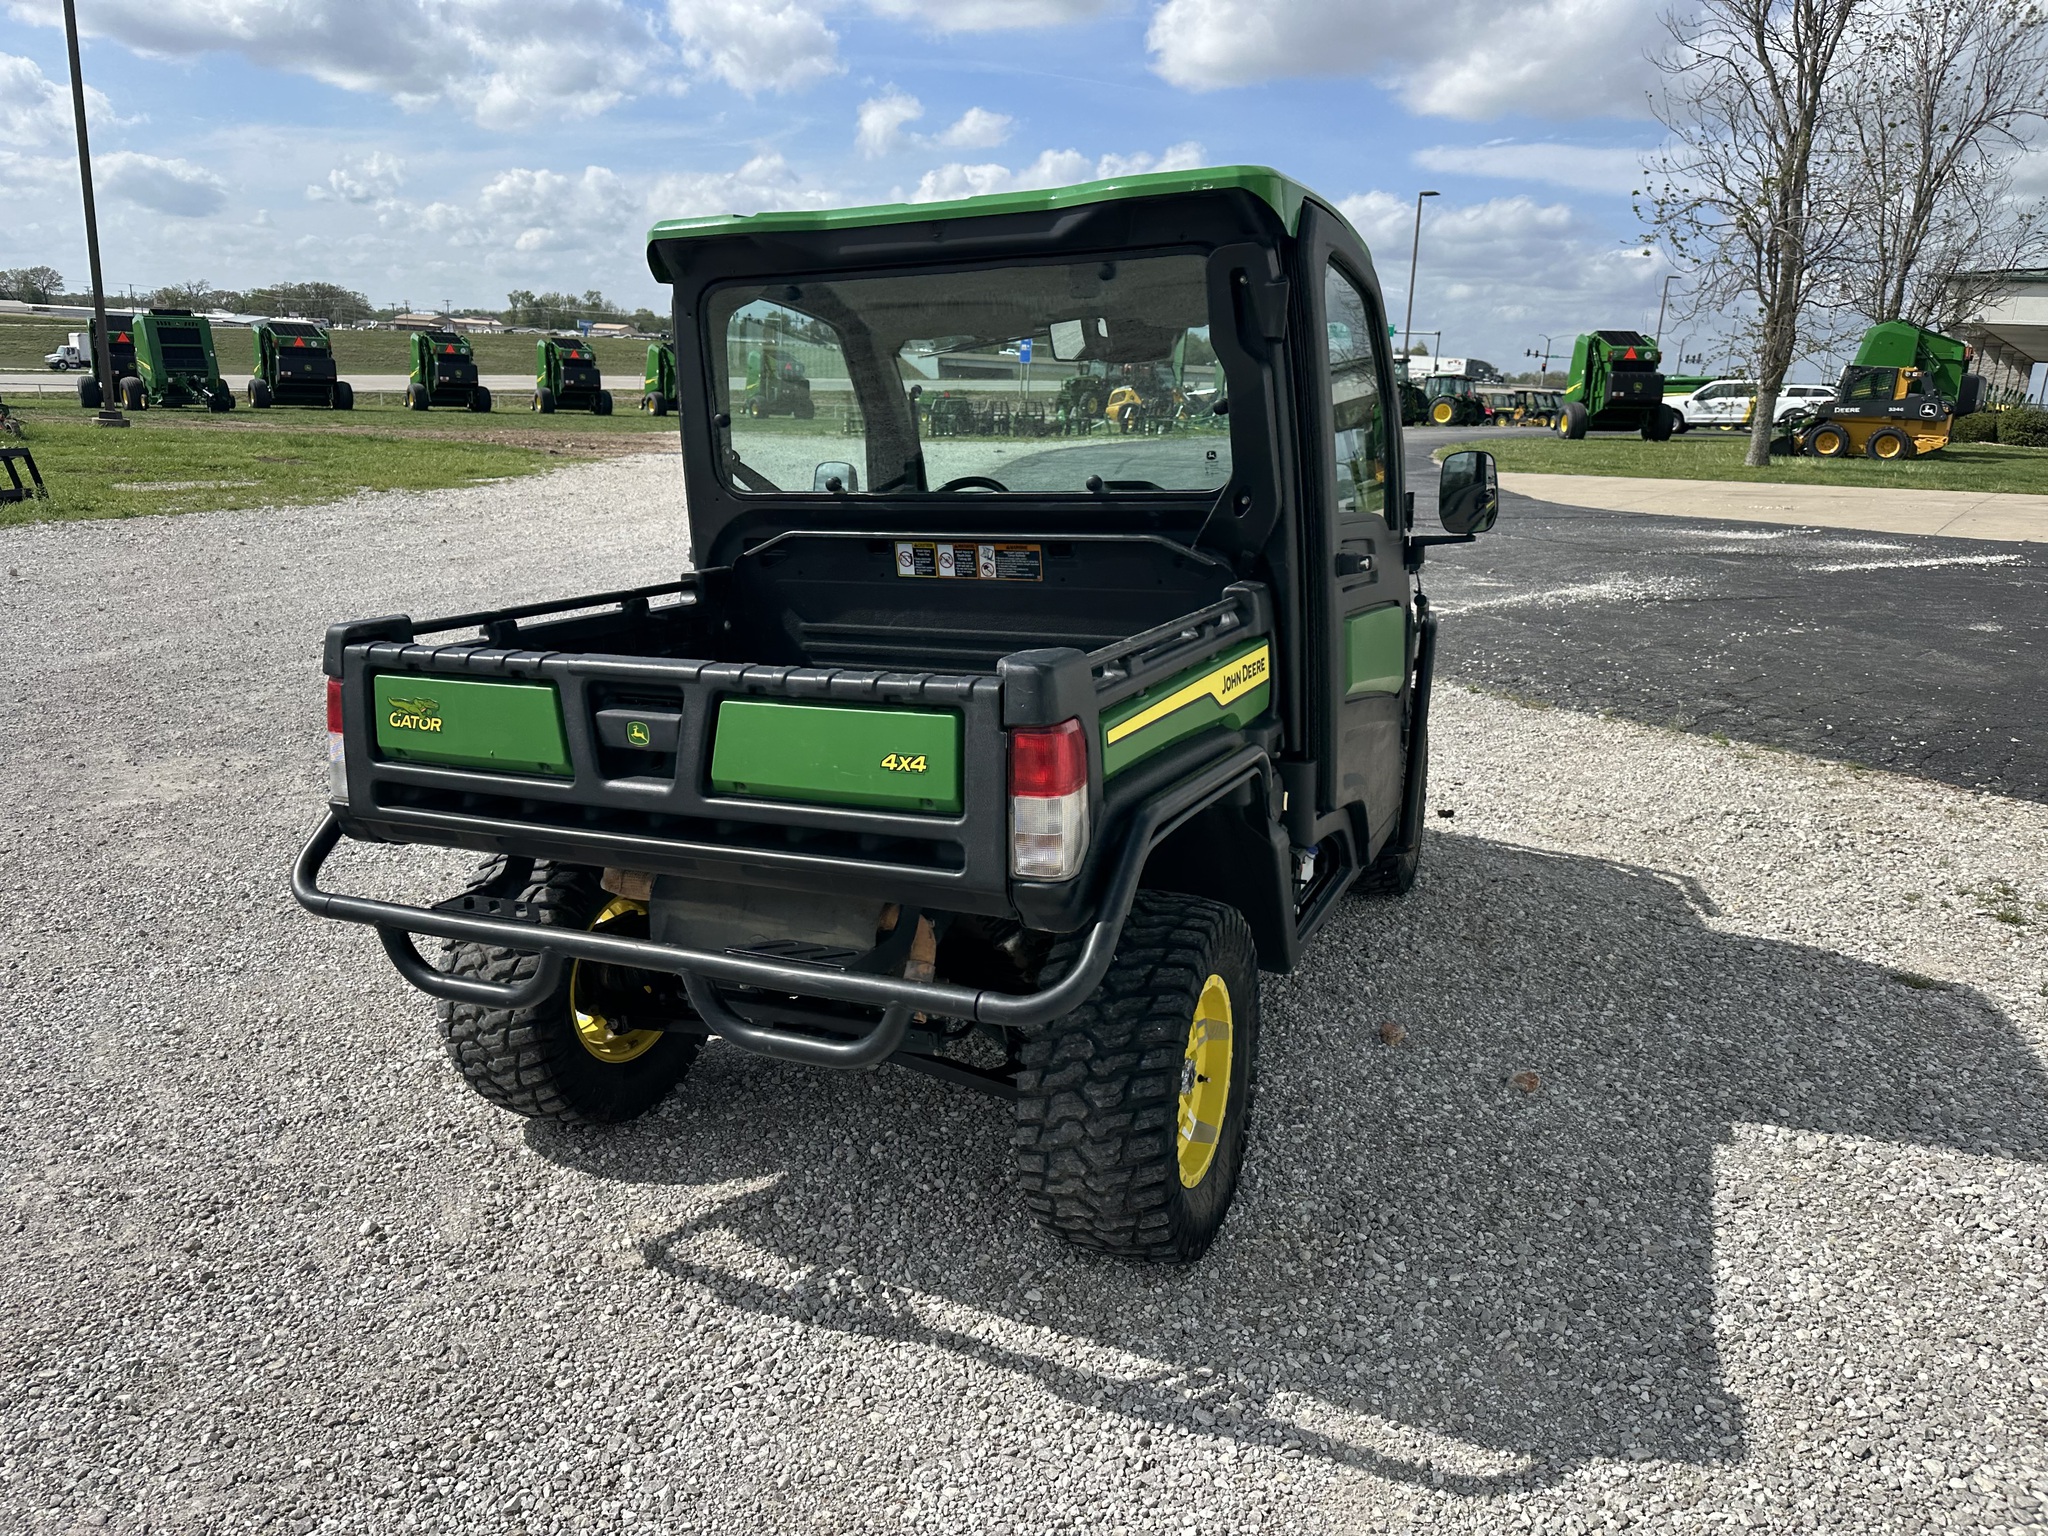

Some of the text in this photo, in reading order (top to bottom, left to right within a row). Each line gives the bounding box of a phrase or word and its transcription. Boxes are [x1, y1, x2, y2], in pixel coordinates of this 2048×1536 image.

[1222, 657, 1266, 694] JOHN DEERE
[389, 712, 442, 732] GATOR
